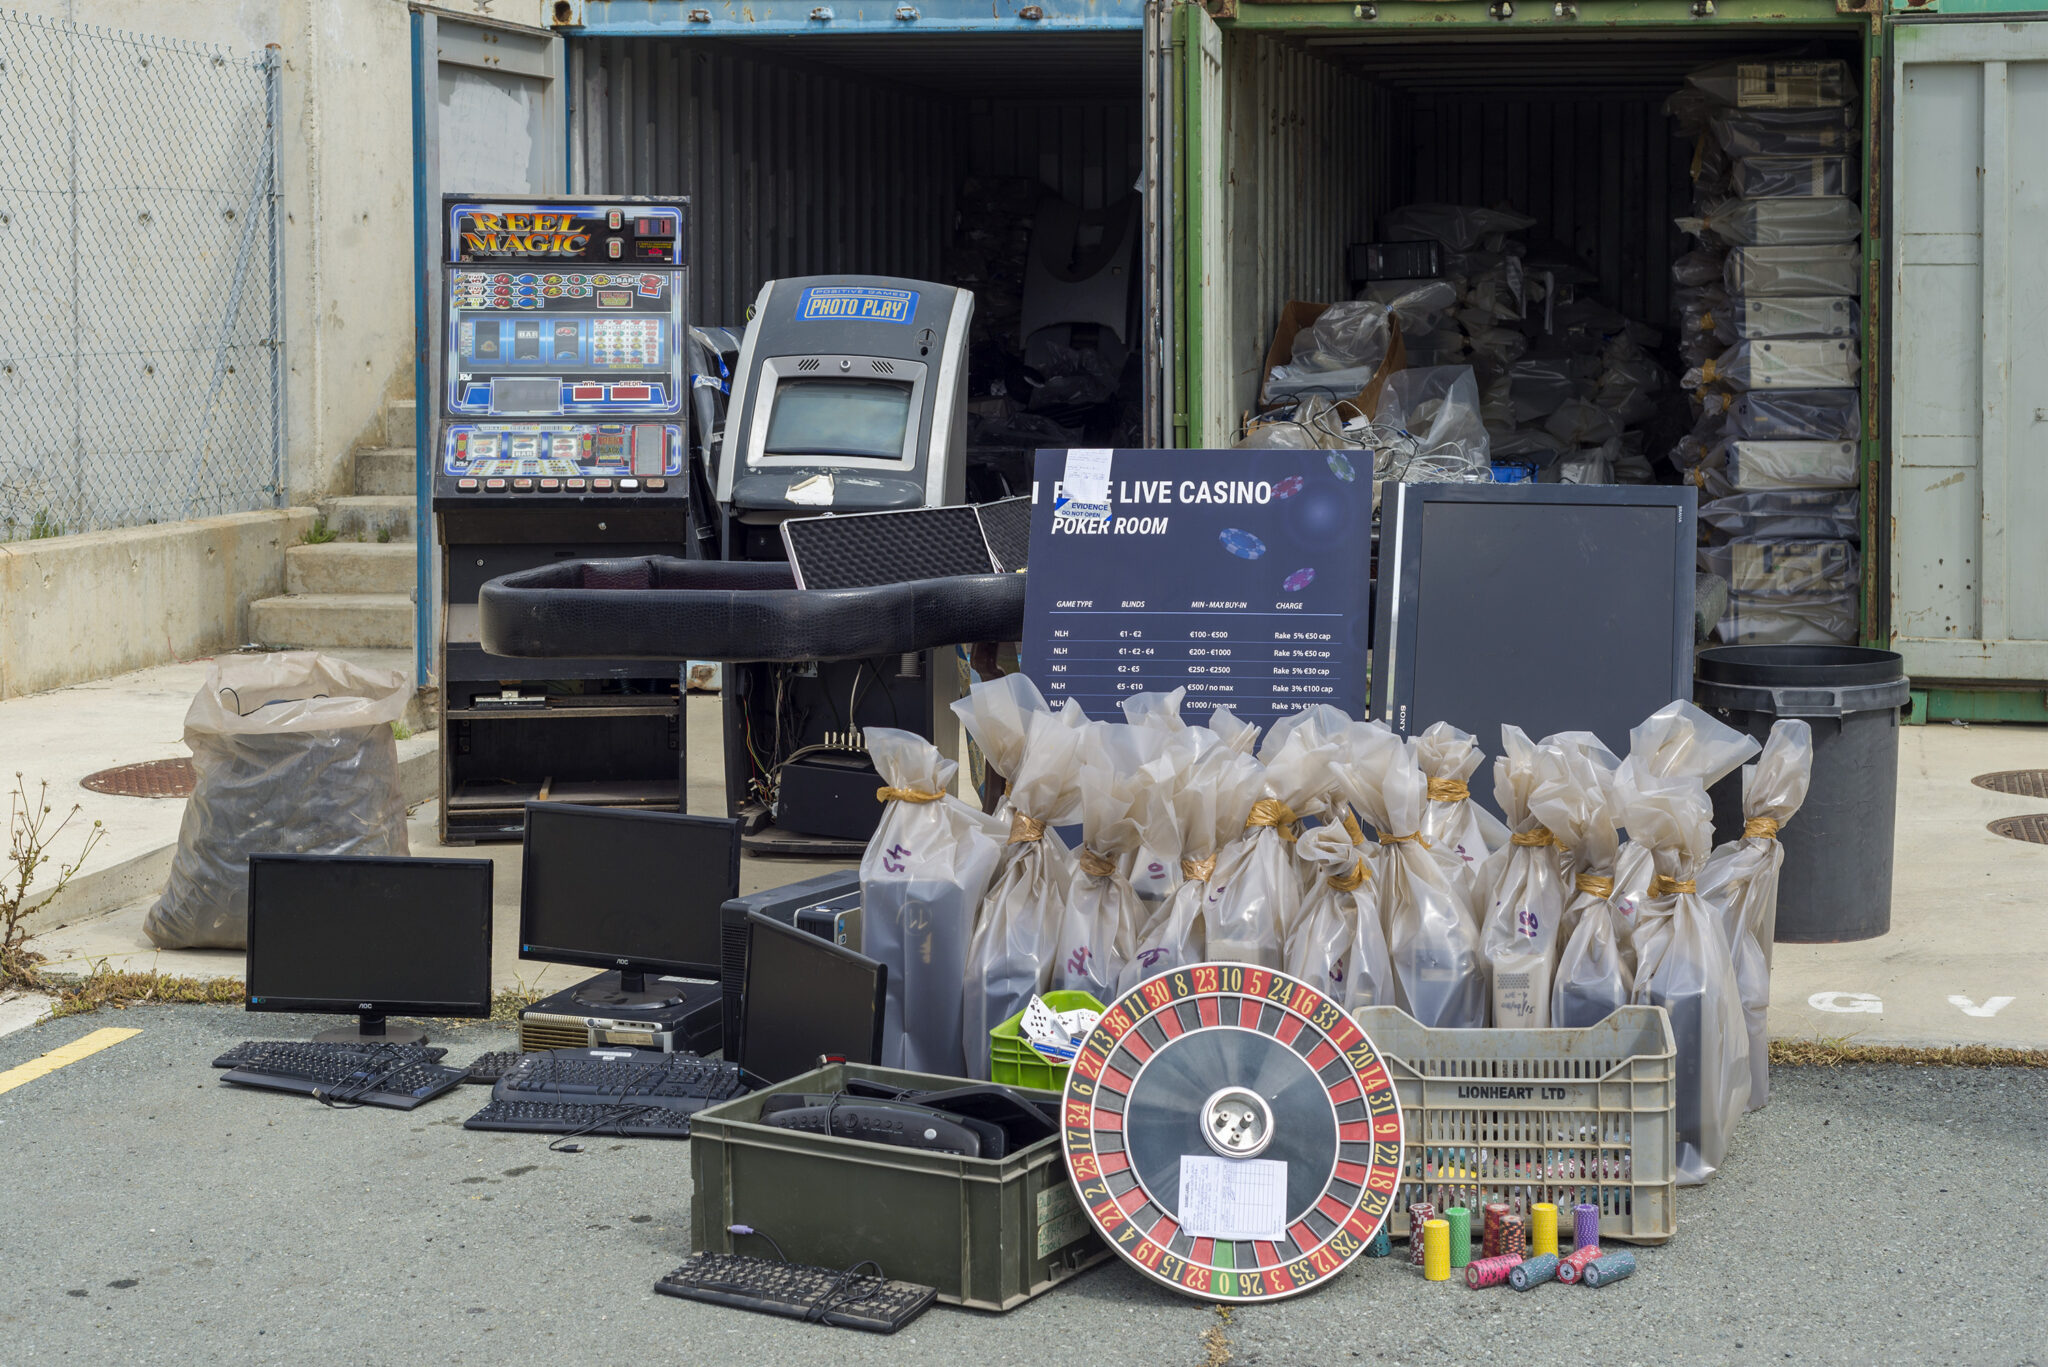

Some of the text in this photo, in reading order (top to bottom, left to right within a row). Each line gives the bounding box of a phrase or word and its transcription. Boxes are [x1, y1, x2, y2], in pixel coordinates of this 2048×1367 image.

[467, 212, 586, 233] REEL
[462, 233, 592, 253] MAGIC
[809, 298, 903, 318] PHOTO PLAY
[1120, 481, 1173, 504] LIVE
[1179, 481, 1272, 505] CASINO
[1071, 502, 1108, 511] EVIDENCE
[1051, 517, 1169, 535] POKER ROOM
[1209, 601, 1224, 609] MAX
[1276, 602, 1303, 610] CHARGE
[1211, 631, 1228, 639] €500
[1305, 632, 1318, 640] €50
[1518, 910, 1538, 937] 18
[616, 958, 629, 966] AOC
[1174, 973, 1188, 997] 8
[1196, 968, 1217, 992] 23
[1221, 967, 1242, 992] 10
[1250, 971, 1262, 995] 5
[1267, 977, 1294, 1005] 24
[1124, 992, 1149, 1020] 11
[1145, 980, 1169, 1008] 30
[1292, 988, 1317, 1015] 16
[1807, 991, 2017, 1017] G V
[1104, 1008, 1130, 1037] 36
[1312, 1003, 1340, 1030] 33
[1089, 1030, 1114, 1057] 13
[1335, 1025, 1354, 1045] 1
[1077, 1050, 1101, 1078] 27
[1346, 1042, 1375, 1069] 20
[1071, 1081, 1093, 1096] 6
[1360, 1066, 1387, 1091] 14
[1369, 1092, 1395, 1115] 31
[1458, 1086, 1566, 1100] LIONHEART LTD
[1068, 1103, 1090, 1126] 34
[1067, 1130, 1092, 1150] 17
[1374, 1122, 1398, 1134] 9
[1374, 1142, 1399, 1165] 22
[1072, 1155, 1098, 1177] 25
[1084, 1183, 1106, 1199] 2
[1369, 1168, 1395, 1190] 18
[1095, 1202, 1123, 1227] 21
[1361, 1190, 1388, 1215] 29
[1118, 1226, 1135, 1243] 4
[1351, 1217, 1373, 1234] 7
[1136, 1241, 1163, 1266] 19
[1331, 1229, 1359, 1257] 28
[1159, 1254, 1185, 1281] 15
[1310, 1246, 1339, 1273] 12
[1186, 1265, 1209, 1290] 32
[1219, 1272, 1230, 1294] 0
[1239, 1272, 1263, 1296] 26
[1270, 1270, 1285, 1292] 3
[1289, 1259, 1316, 1285] 35
